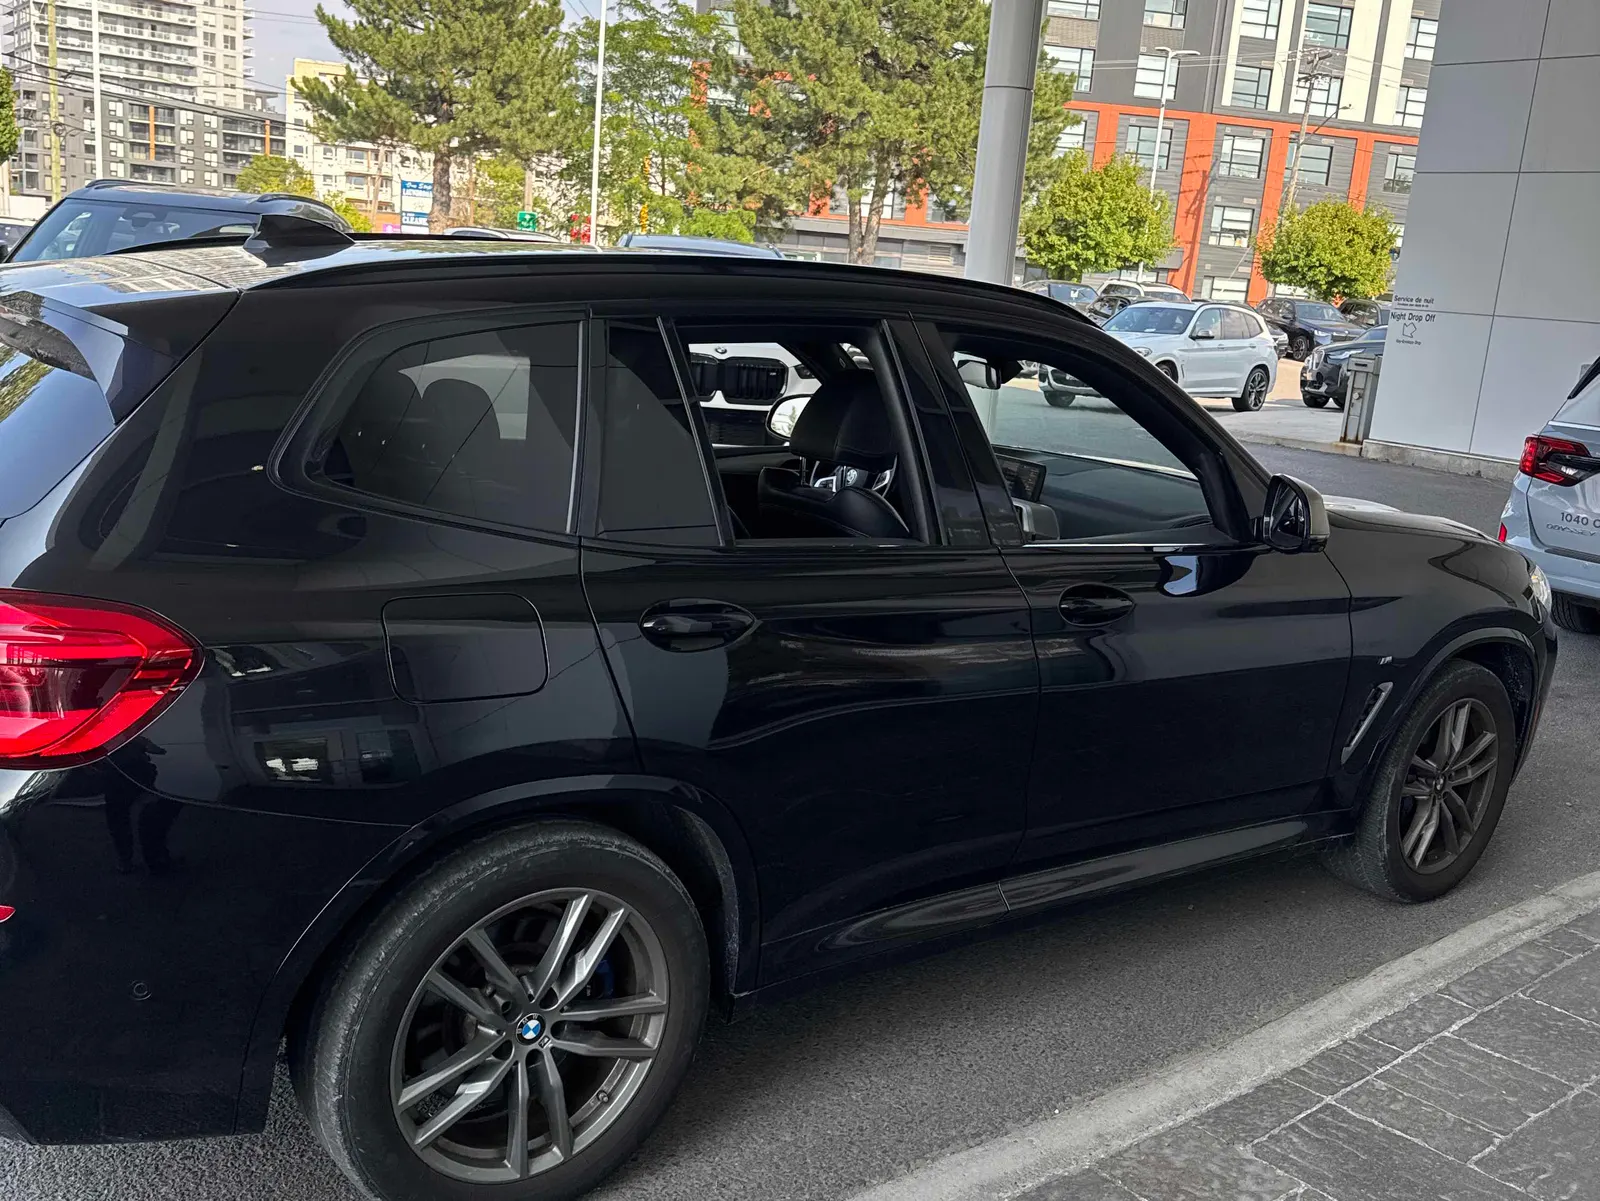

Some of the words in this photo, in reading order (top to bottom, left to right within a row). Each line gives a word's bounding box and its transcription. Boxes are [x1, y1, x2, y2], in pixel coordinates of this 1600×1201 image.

[1394, 294, 1414, 303] Service
[1390, 312, 1406, 322] Night
[1408, 312, 1423, 323] Drop
[1425, 313, 1436, 322] Off
[1561, 512, 1589, 526] 1040
